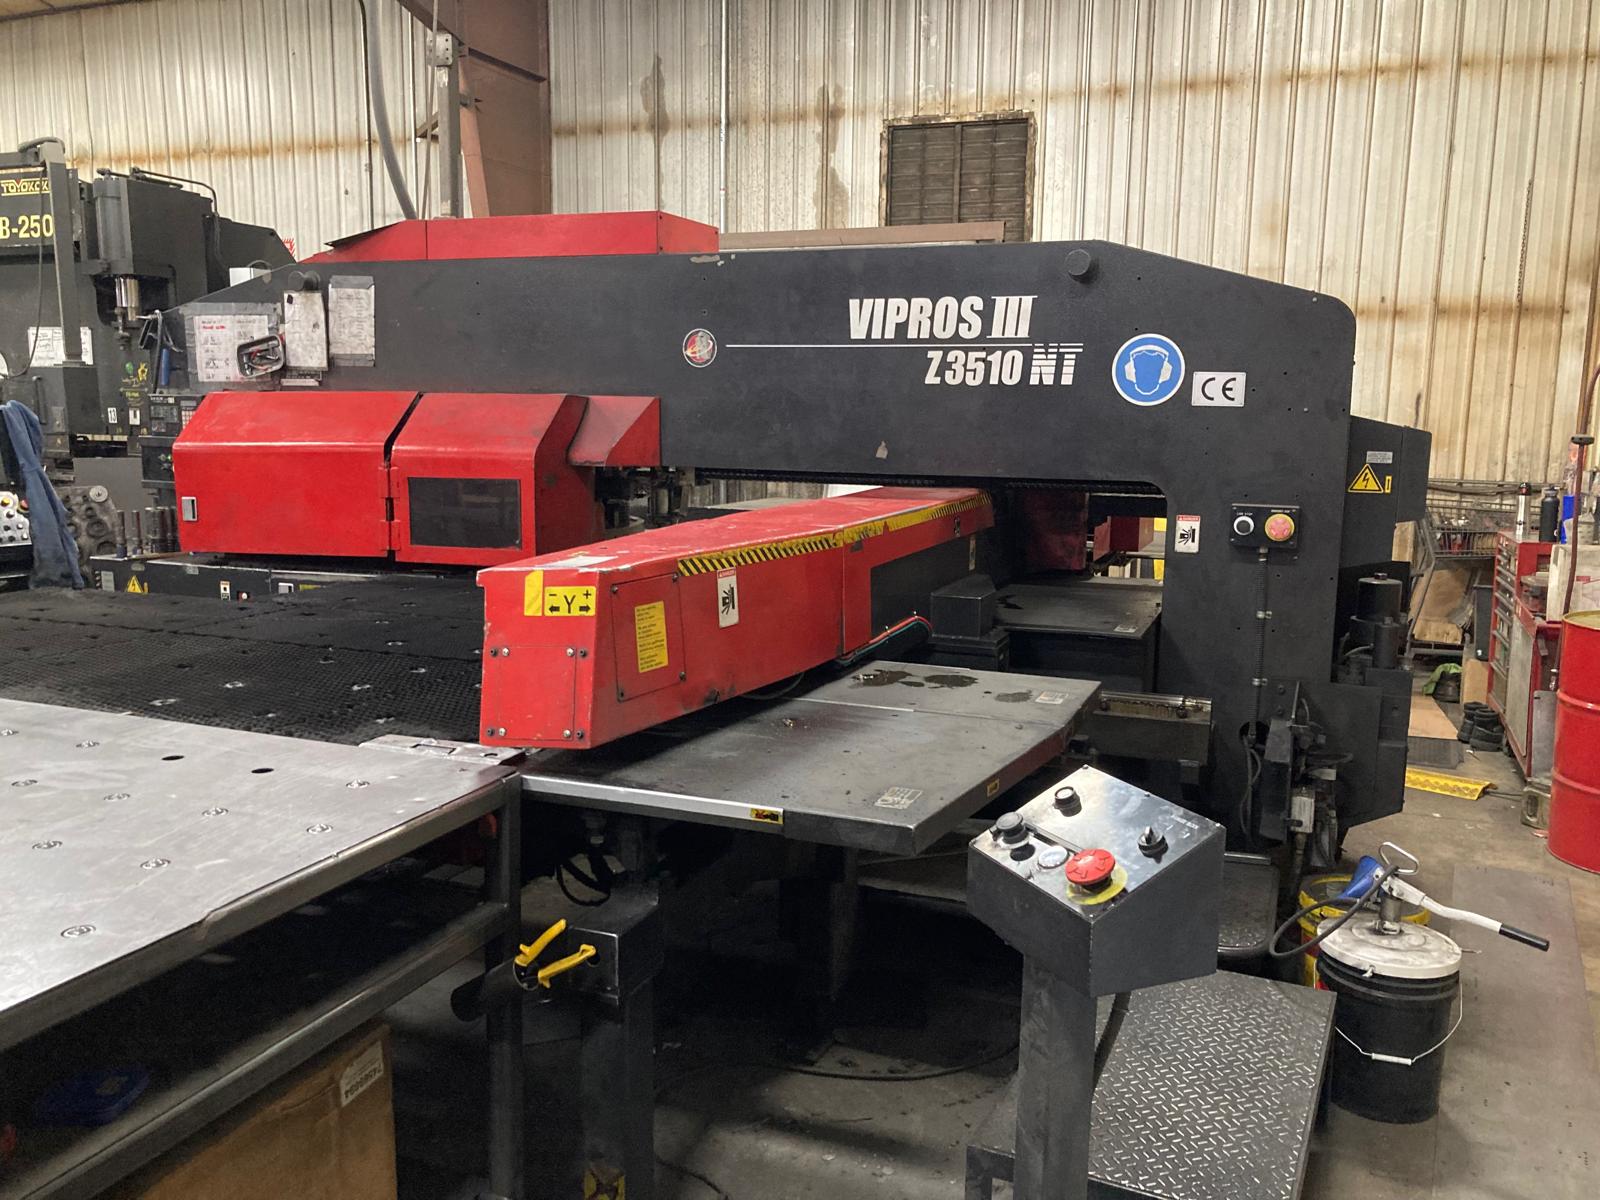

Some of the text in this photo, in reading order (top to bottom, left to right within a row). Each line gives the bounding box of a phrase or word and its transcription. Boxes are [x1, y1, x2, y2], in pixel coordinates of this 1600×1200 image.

[848, 294, 1038, 340] VIPROS III
[1030, 342, 1083, 385] NT
[1201, 377, 1237, 401] CE
[564, 595, 576, 614] Y
